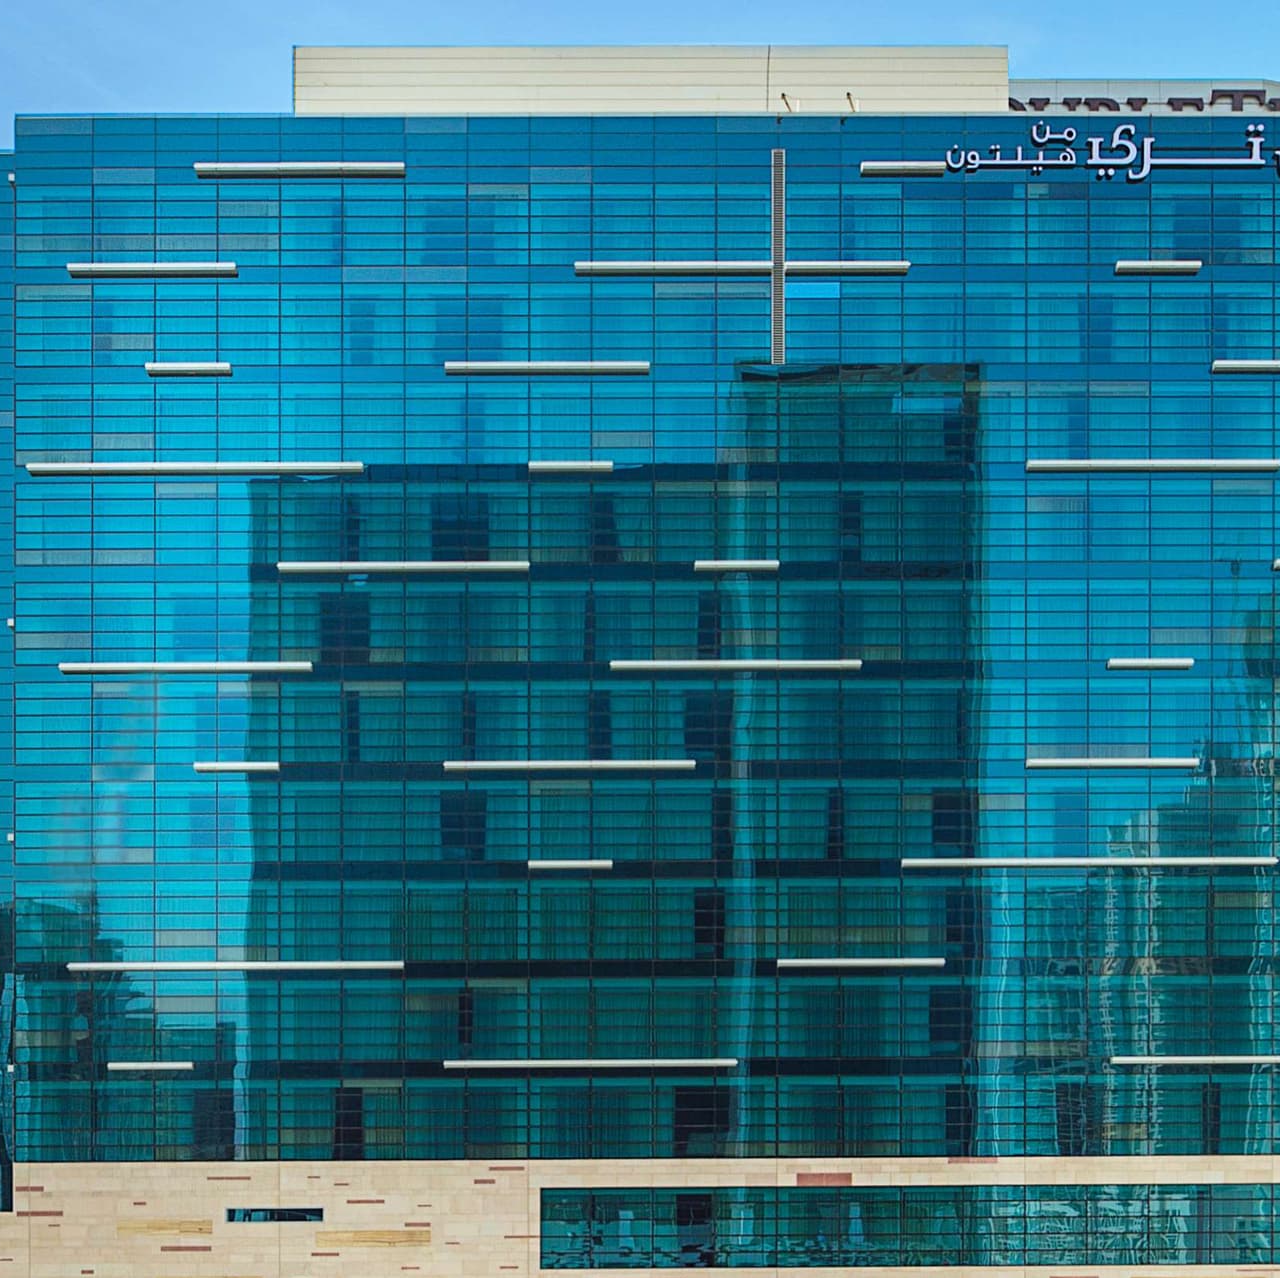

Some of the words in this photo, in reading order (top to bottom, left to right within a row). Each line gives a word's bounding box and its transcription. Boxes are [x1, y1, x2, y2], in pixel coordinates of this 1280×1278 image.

[1031, 120, 1077, 143] من
[946, 144, 1077, 172] هيلتون
[1085, 123, 1267, 181] تري
